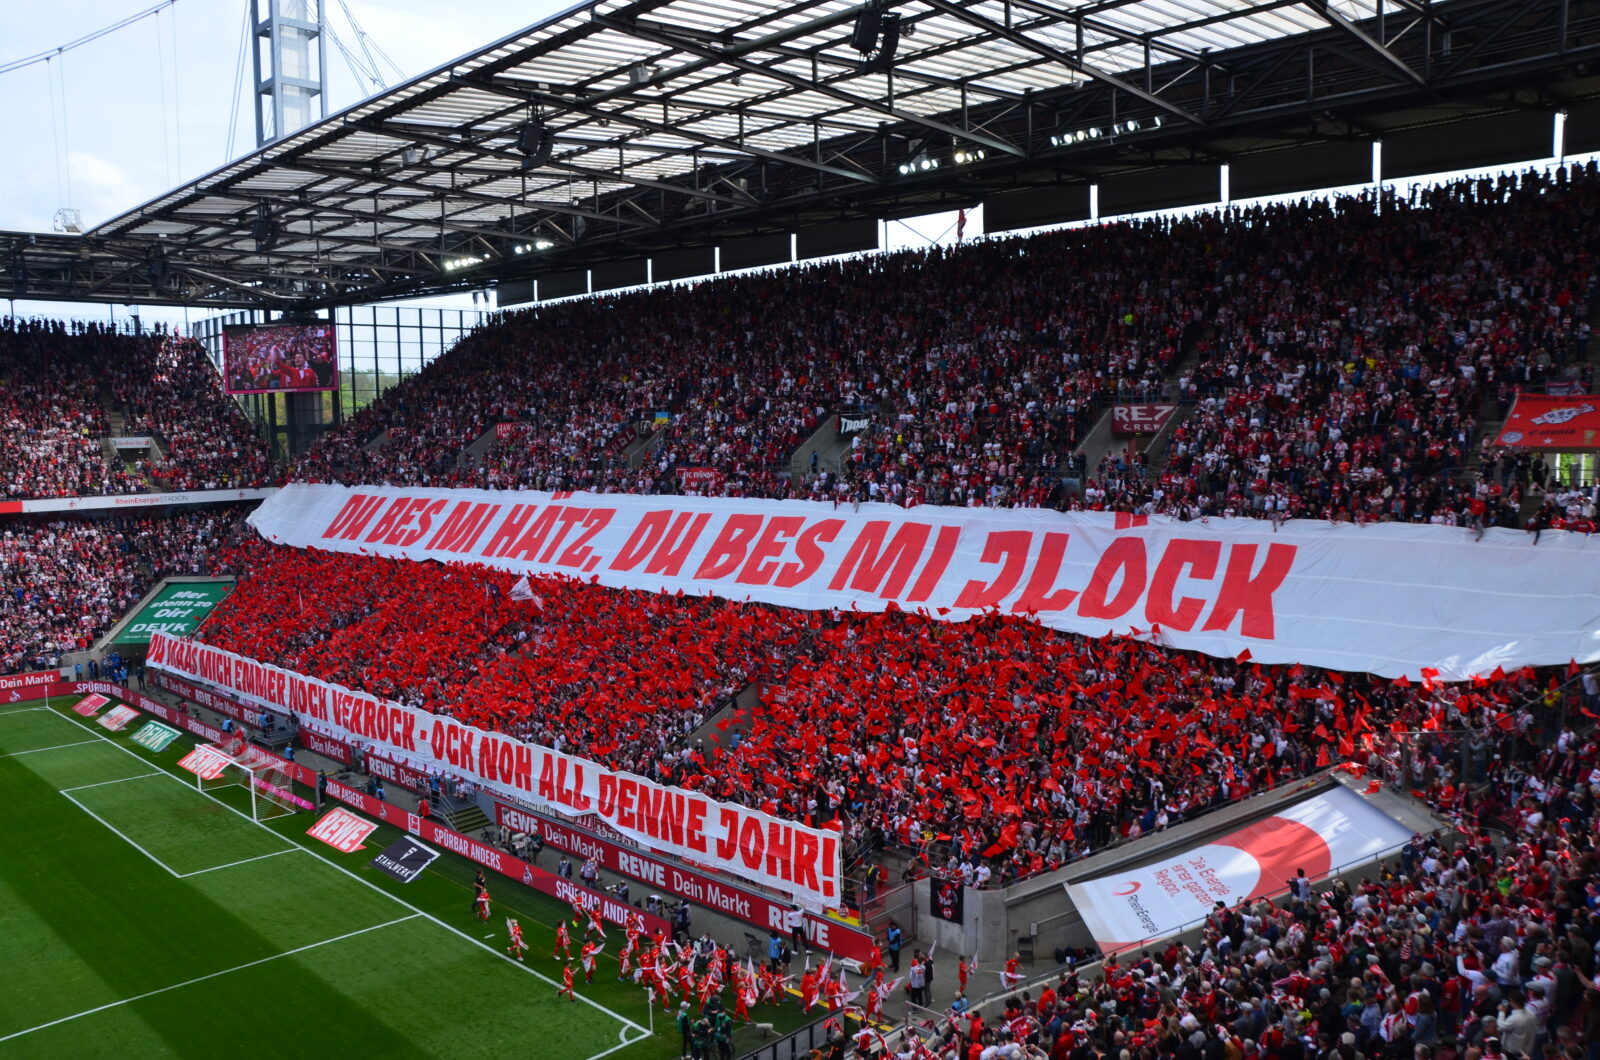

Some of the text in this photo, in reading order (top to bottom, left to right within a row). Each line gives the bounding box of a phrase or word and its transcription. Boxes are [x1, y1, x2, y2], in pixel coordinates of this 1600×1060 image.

[321, 490, 1298, 640] DU BES MI HÄTZ, DU BES MI JLÖCK
[170, 590, 209, 600] Mer
[153, 607, 194, 618] Dir!
[129, 622, 190, 633] DEVK
[0, 673, 55, 689] Dein Markt
[76, 681, 111, 693] SPÜRBAR
[133, 723, 174, 750] DEVK
[309, 735, 345, 760] Dein Markt
[146, 633, 167, 664] DU
[167, 637, 199, 676] MÄÄS
[200, 648, 233, 688] MICH
[234, 659, 287, 707] EMMER
[288, 675, 329, 722] NOCH
[431, 719, 476, 773] OCH
[479, 735, 533, 792] NOH
[538, 752, 592, 812] ALL
[598, 773, 708, 854] DENNE
[716, 807, 836, 897] JOHR!
[368, 756, 397, 781] REWE
[400, 769, 417, 788] Dein
[311, 809, 373, 851] REWE
[434, 827, 504, 872] SPÜRBAR ANDERS.
[374, 853, 411, 879] STAHLWERK
[501, 805, 538, 835] REWE
[543, 824, 568, 849] Dein
[570, 833, 606, 863] Markt
[618, 851, 666, 887] REWE
[673, 870, 703, 899] Dein
[703, 883, 751, 919] Markt
[768, 904, 829, 948] REWE
[556, 880, 601, 912] SPÜBAR
[1154, 868, 1180, 897] Region.
[1171, 864, 1217, 908] einer ganzen
[1199, 867, 1231, 896] Energie
[1127, 893, 1159, 934] RheinEnergie
